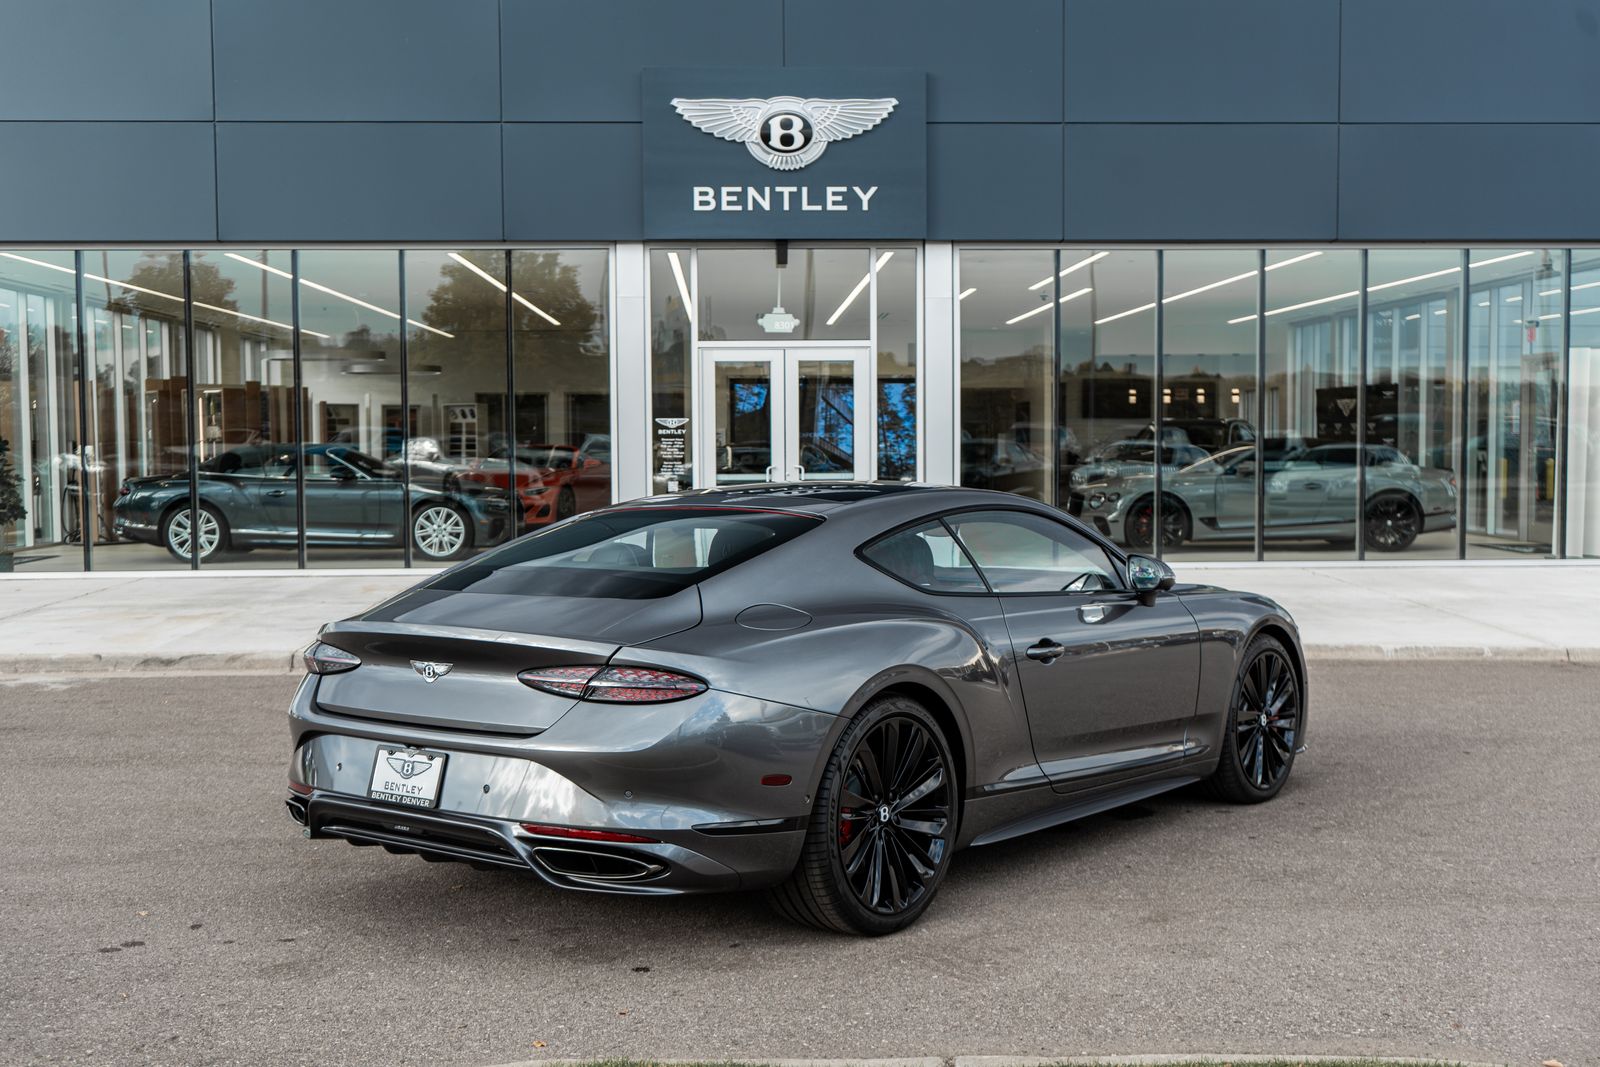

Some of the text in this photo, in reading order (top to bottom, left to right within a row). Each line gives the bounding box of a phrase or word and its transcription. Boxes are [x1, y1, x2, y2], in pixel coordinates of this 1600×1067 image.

[768, 115, 805, 151] B
[693, 186, 878, 211] BENTLEY
[425, 665, 434, 677] B
[403, 762, 412, 774] B
[384, 781, 423, 795] BENTLEY
[371, 791, 430, 807] BENTLEY DENVER
[880, 806, 889, 822] B
